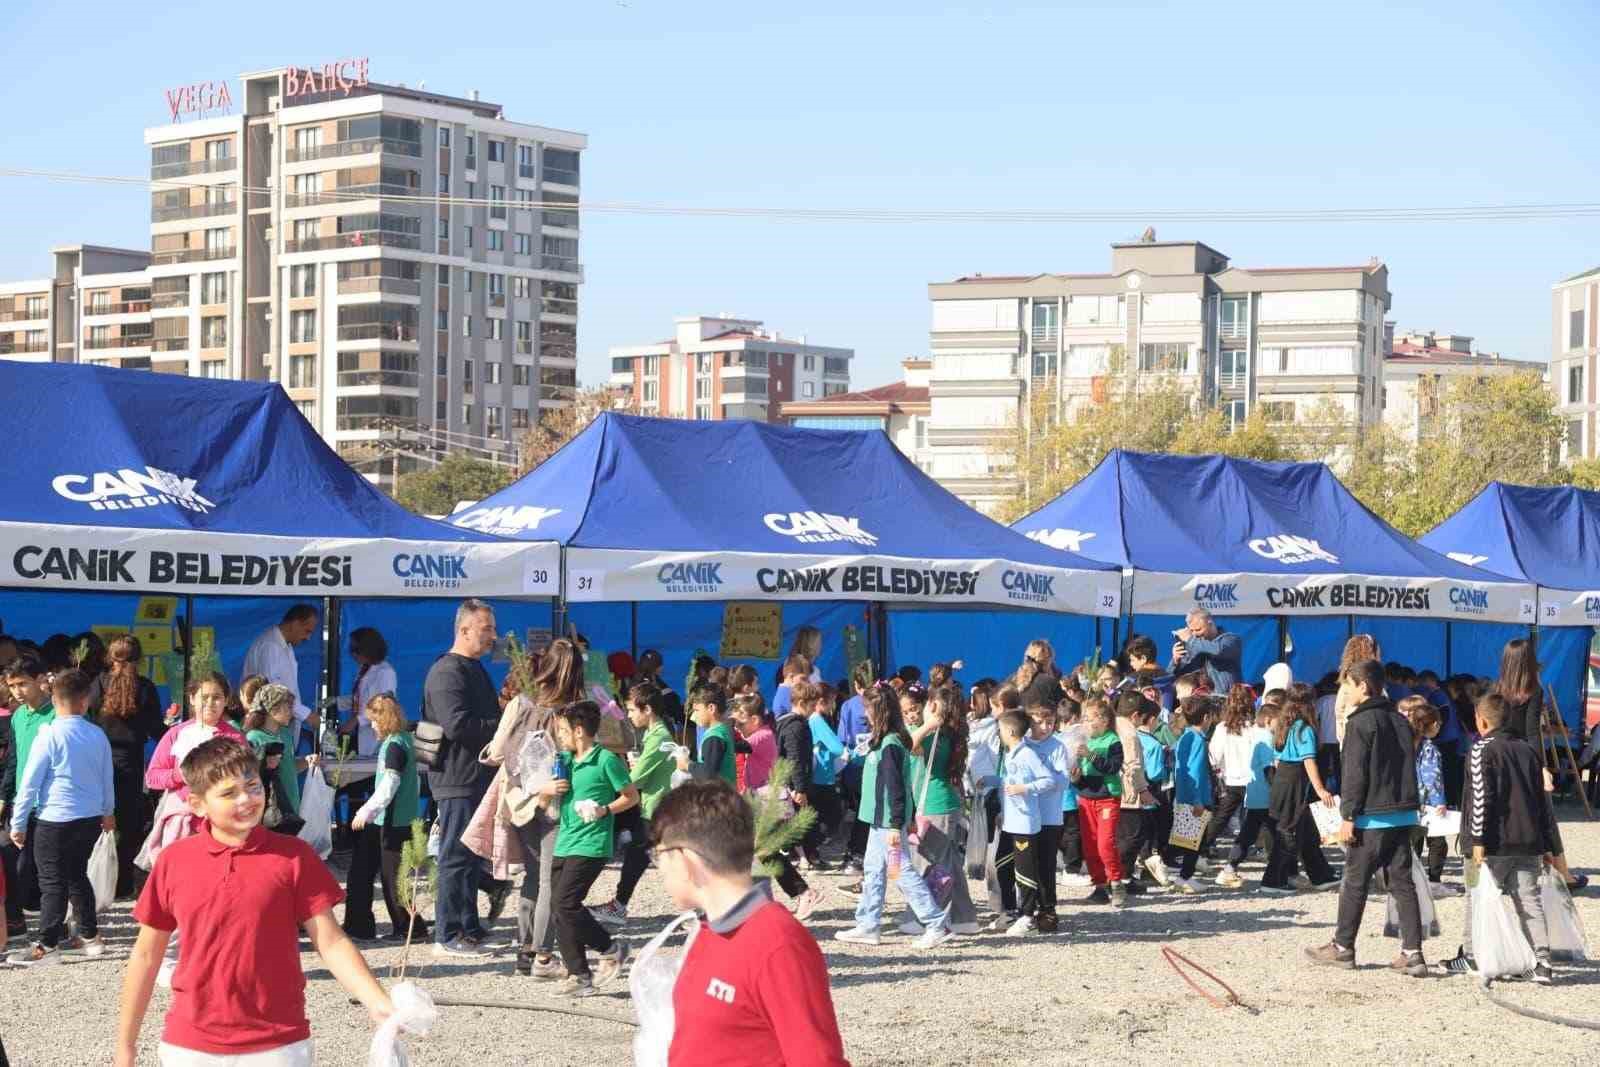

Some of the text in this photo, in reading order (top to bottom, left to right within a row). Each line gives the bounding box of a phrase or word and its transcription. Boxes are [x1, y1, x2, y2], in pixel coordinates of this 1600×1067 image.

[164, 57, 368, 118] VEGA BAHÇE
[532, 570, 547, 584] 30
[578, 577, 592, 590] 31
[1102, 595, 1114, 607] 32
